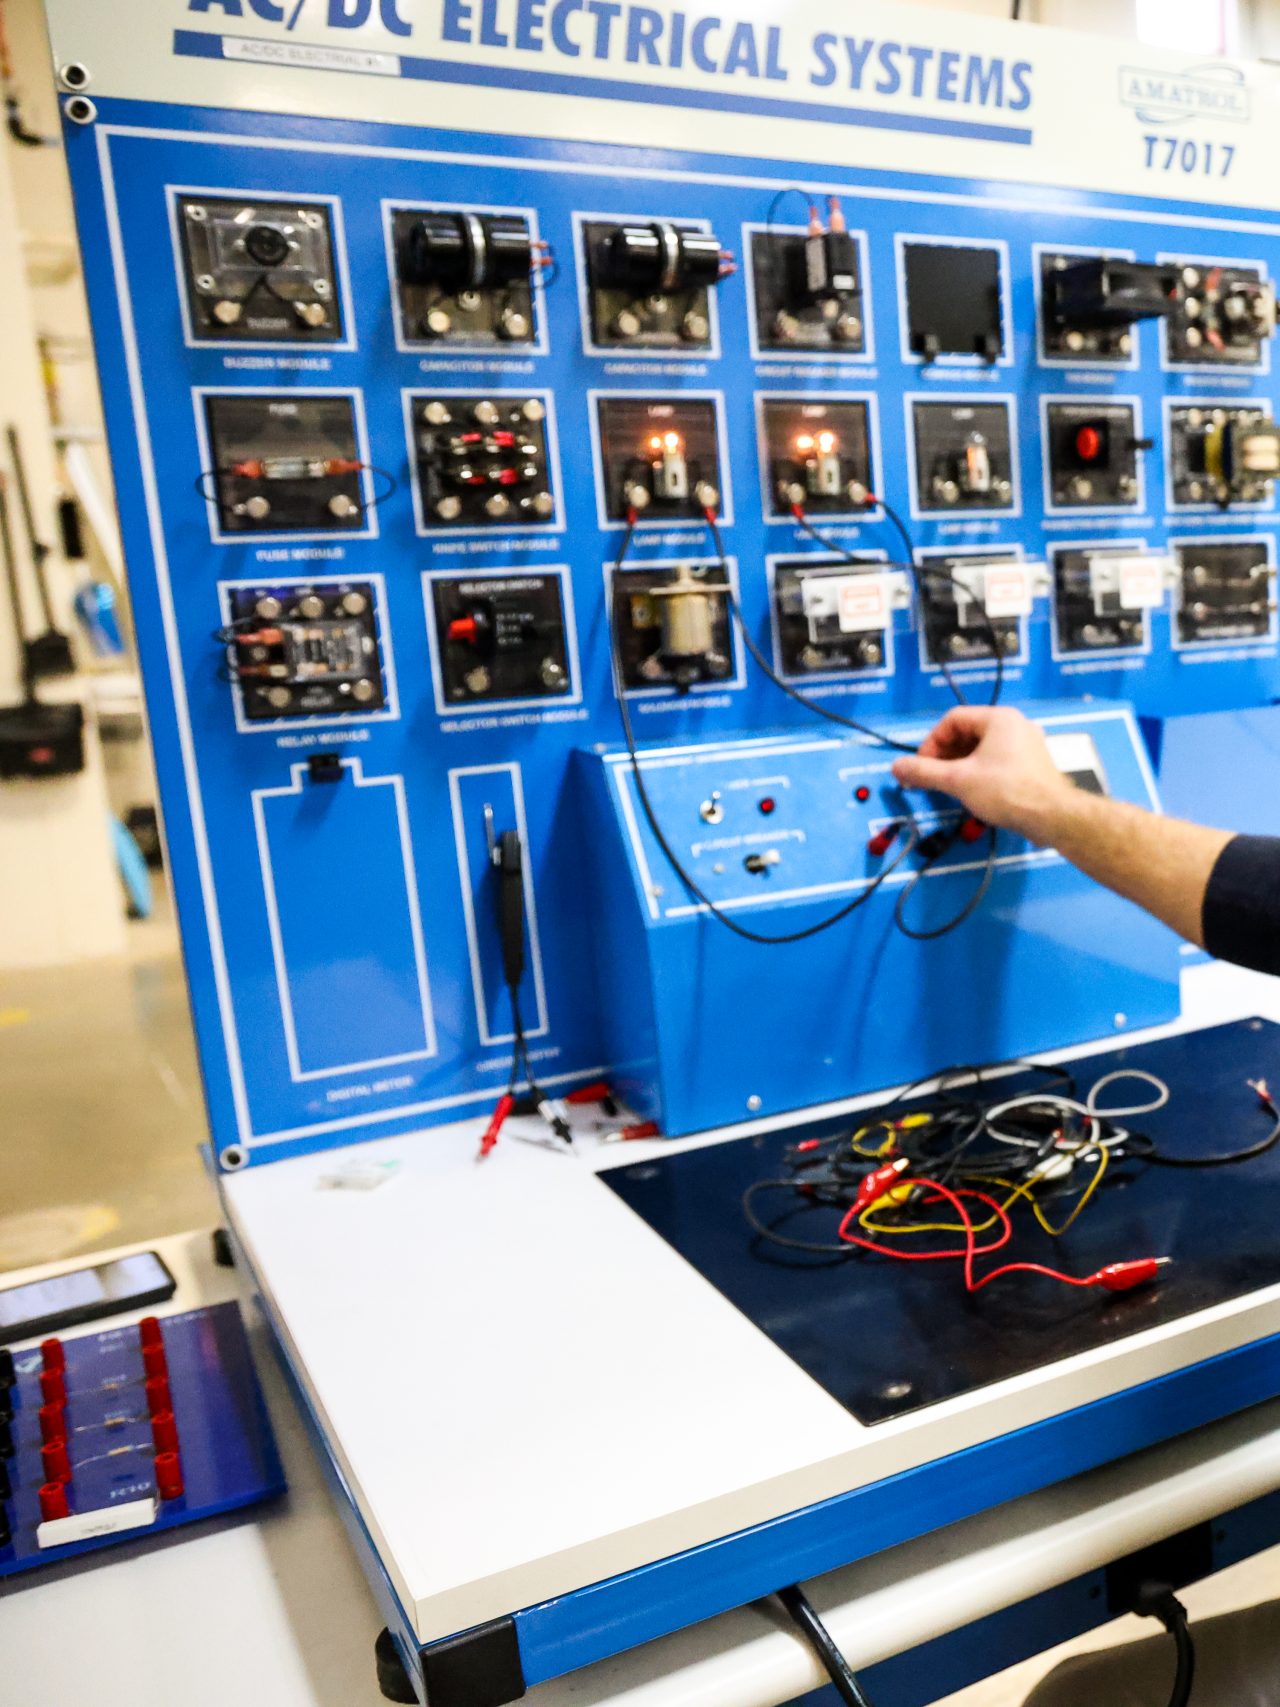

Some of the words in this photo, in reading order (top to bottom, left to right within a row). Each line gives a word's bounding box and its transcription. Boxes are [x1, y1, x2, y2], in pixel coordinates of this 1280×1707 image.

[187, 0, 413, 37] /DC
[440, 0, 789, 81] ELECTRICAL
[809, 32, 1033, 112] SYSTEMS
[1129, 78, 1243, 111] AMATROL
[1142, 133, 1236, 177] T7017
